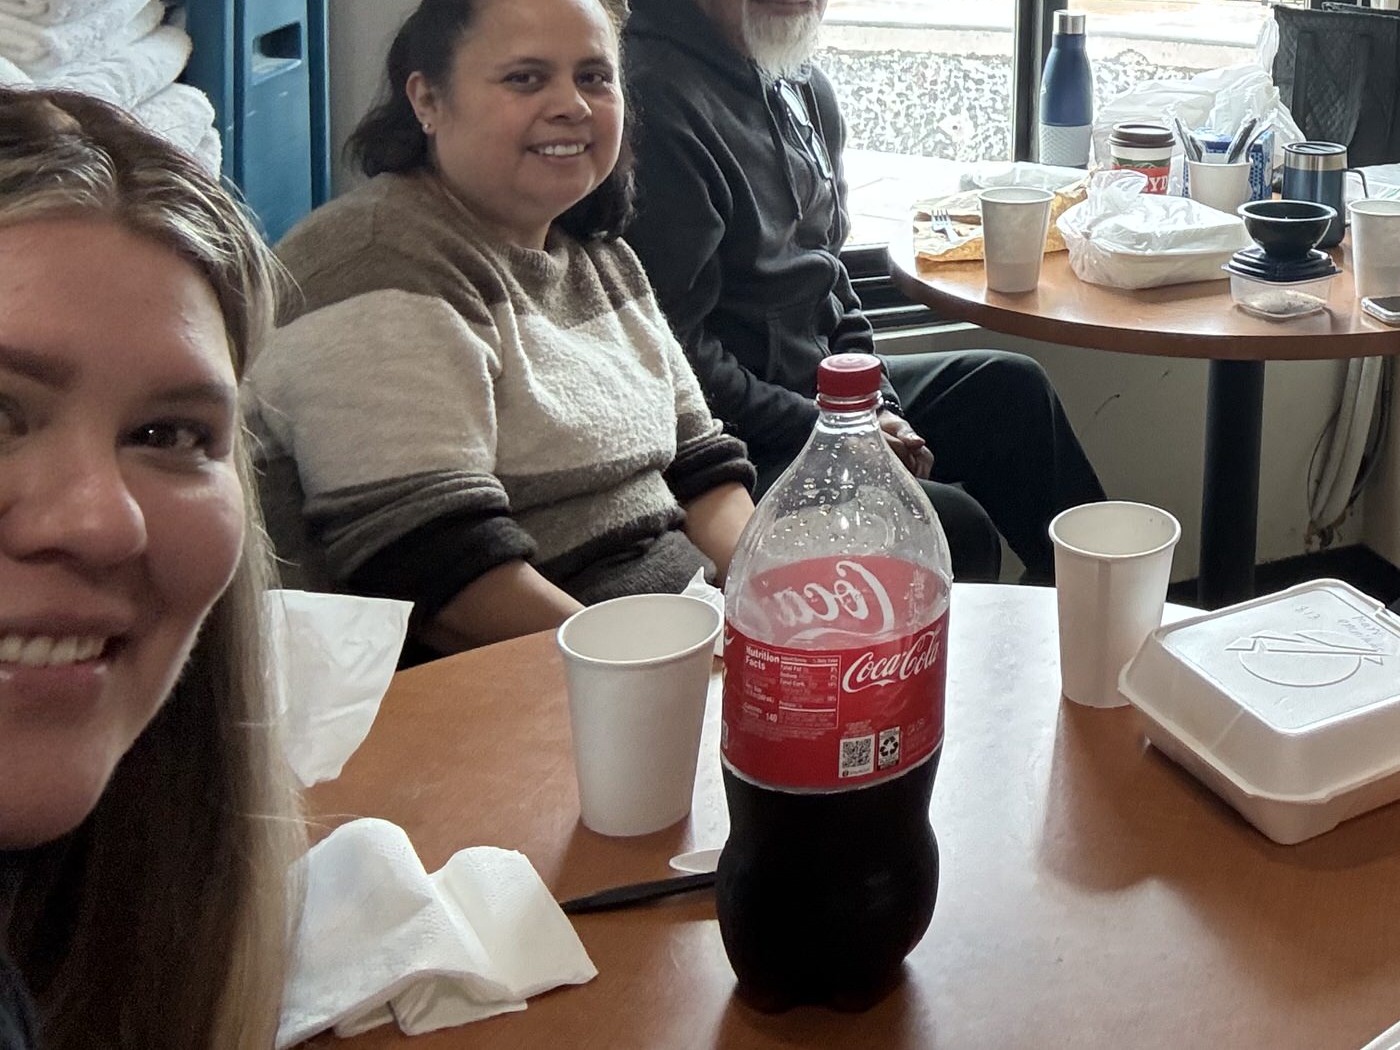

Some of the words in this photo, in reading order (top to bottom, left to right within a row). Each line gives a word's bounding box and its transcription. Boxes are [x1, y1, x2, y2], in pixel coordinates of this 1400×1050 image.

[745, 645, 780, 664] Nutrition
[745, 656, 766, 671] Facts
[766, 712, 778, 723] 140
